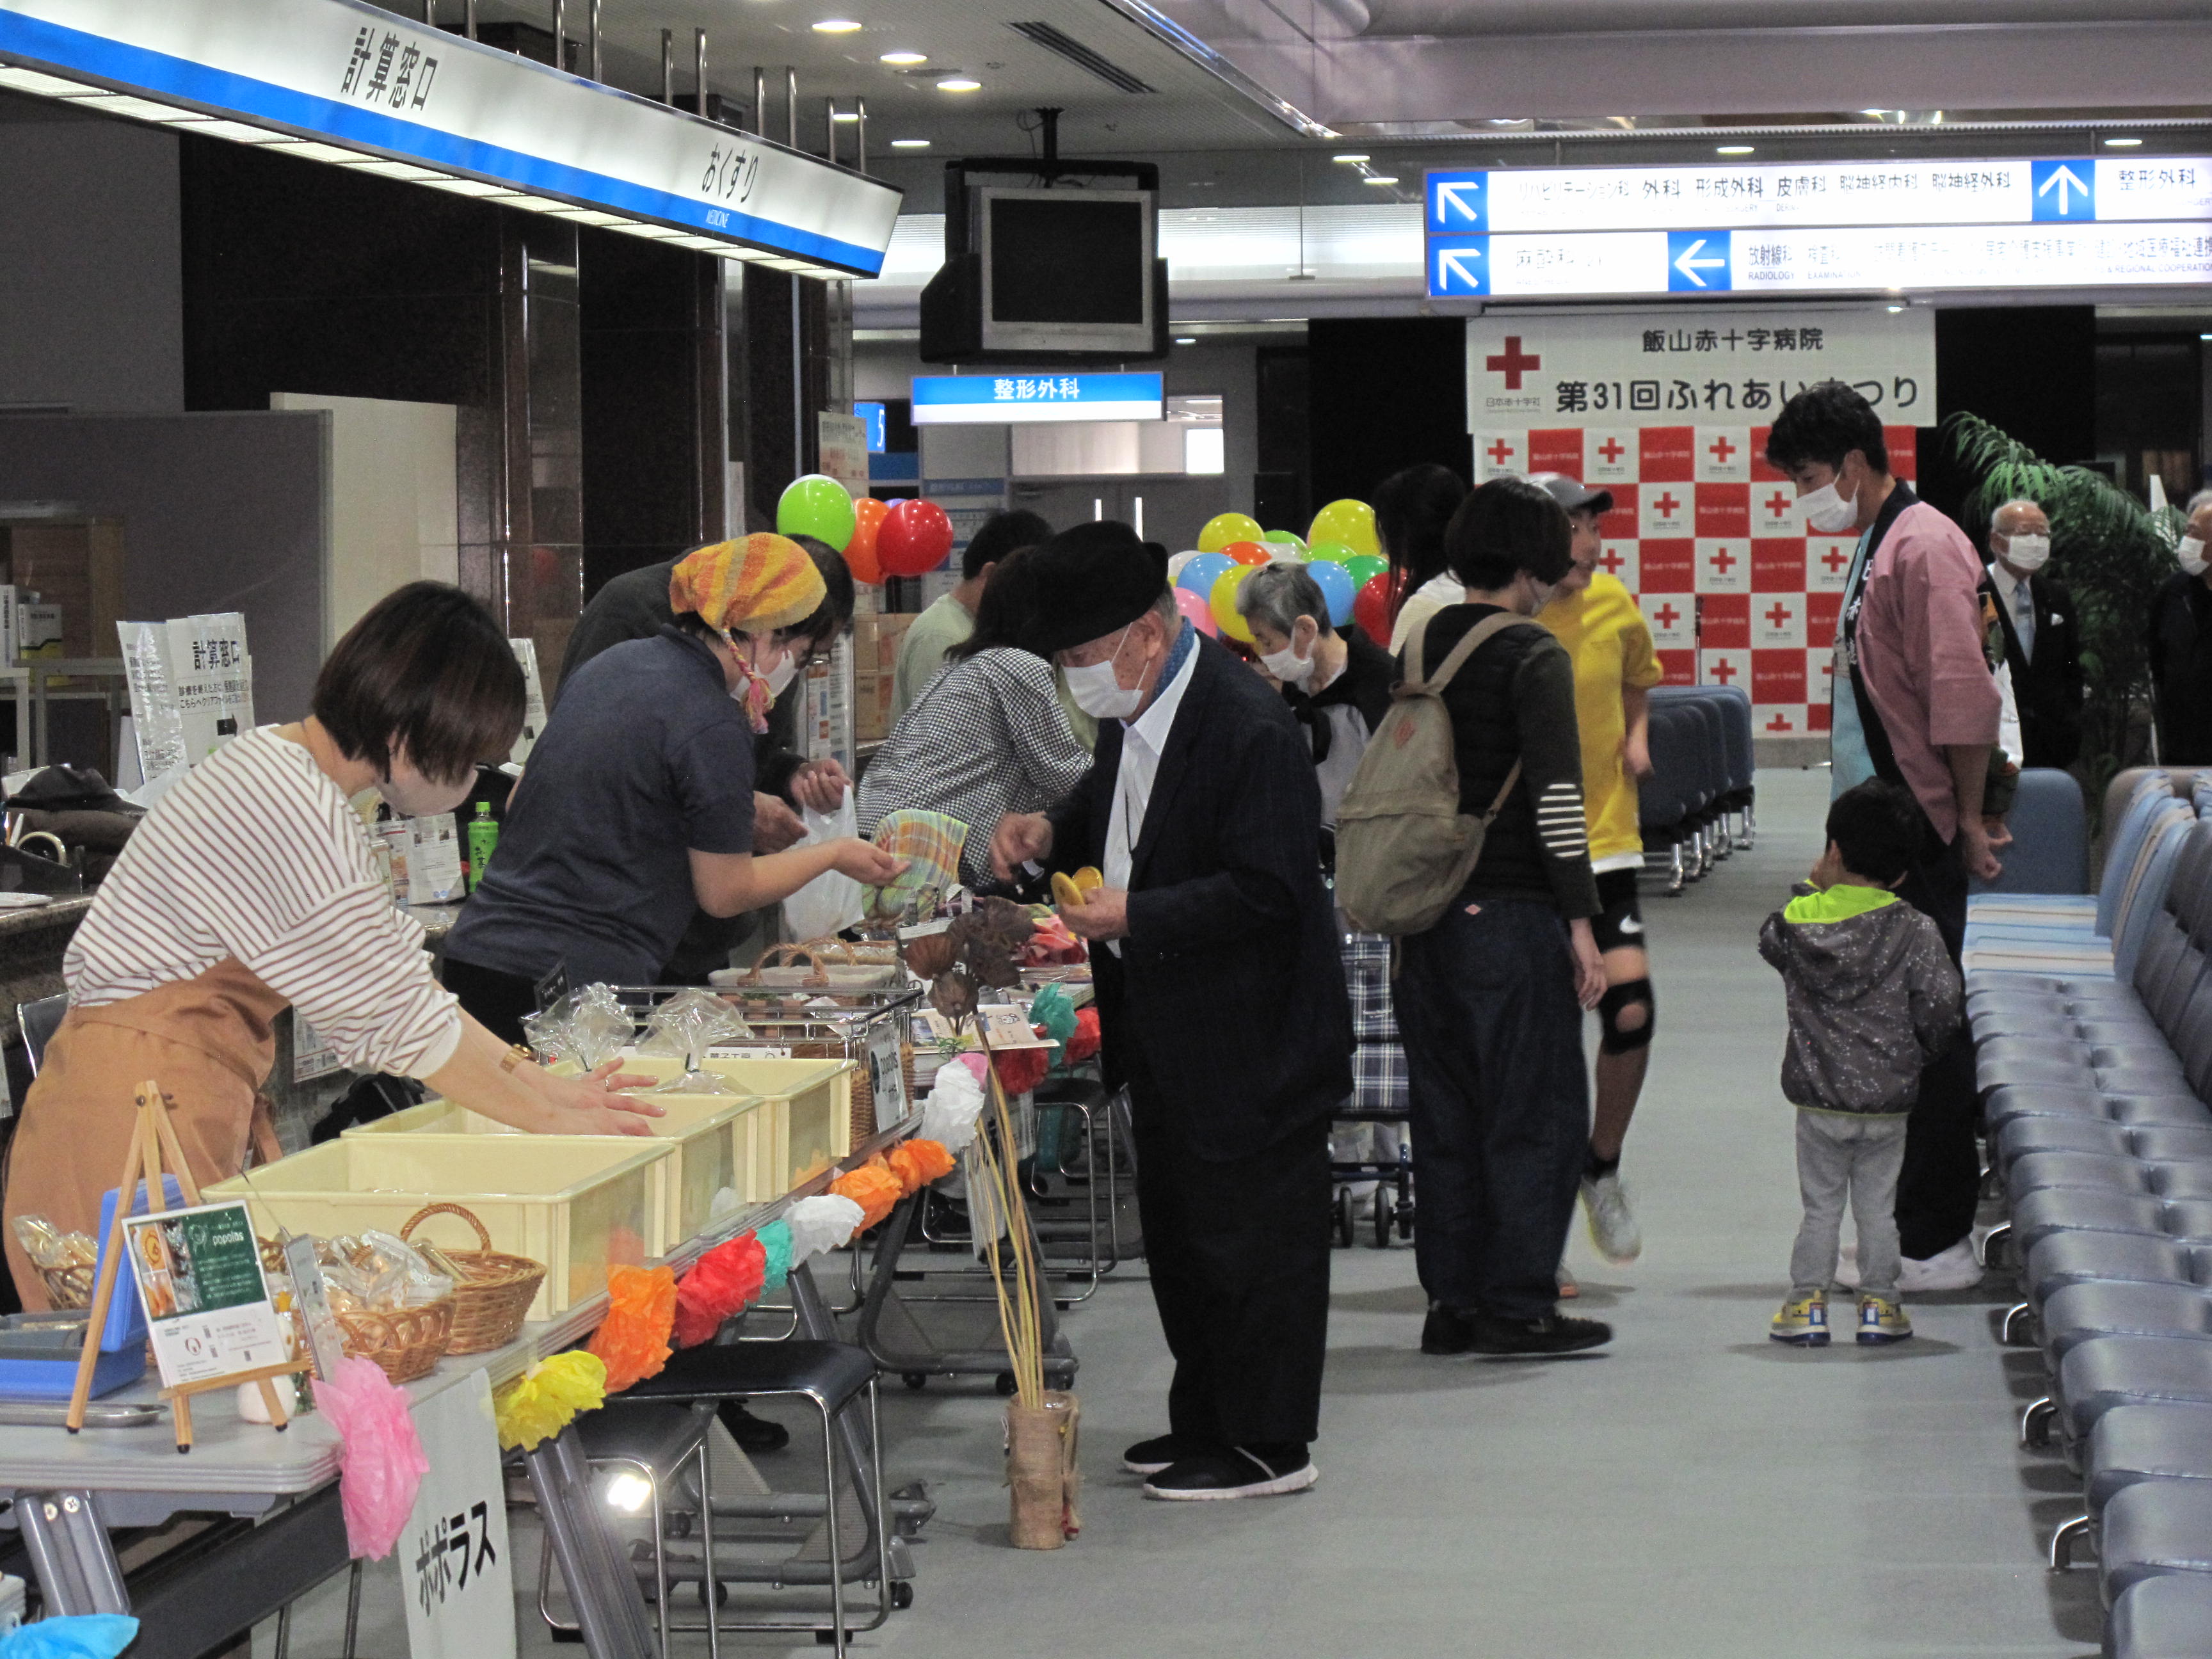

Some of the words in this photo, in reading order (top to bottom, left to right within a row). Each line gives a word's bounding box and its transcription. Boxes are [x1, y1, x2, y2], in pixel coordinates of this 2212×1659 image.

[341, 27, 438, 111] 計算窓口
[701, 142, 758, 203] おくすり
[1642, 179, 1681, 200] 外科
[1696, 177, 1764, 198] 形成外科
[1777, 176, 1826, 196] 皮膚科
[1839, 173, 1918, 192] 脳神経内科
[1932, 171, 2011, 192] 脳神経外科
[2118, 168, 2197, 191] 整形外科
[1749, 244, 1793, 266] 放射線科
[2115, 265, 2156, 273] REGIONAL
[1749, 270, 1795, 281] RADIOLOGY
[1642, 327, 1823, 352] 飯山赤十字病院
[993, 378, 1080, 400] 整形外科
[1556, 376, 1918, 413] 第31回ふれあいつり
[876, 408, 885, 447] 5
[192, 638, 240, 671] 計算窓口
[415, 1500, 496, 1617] ポポラス
